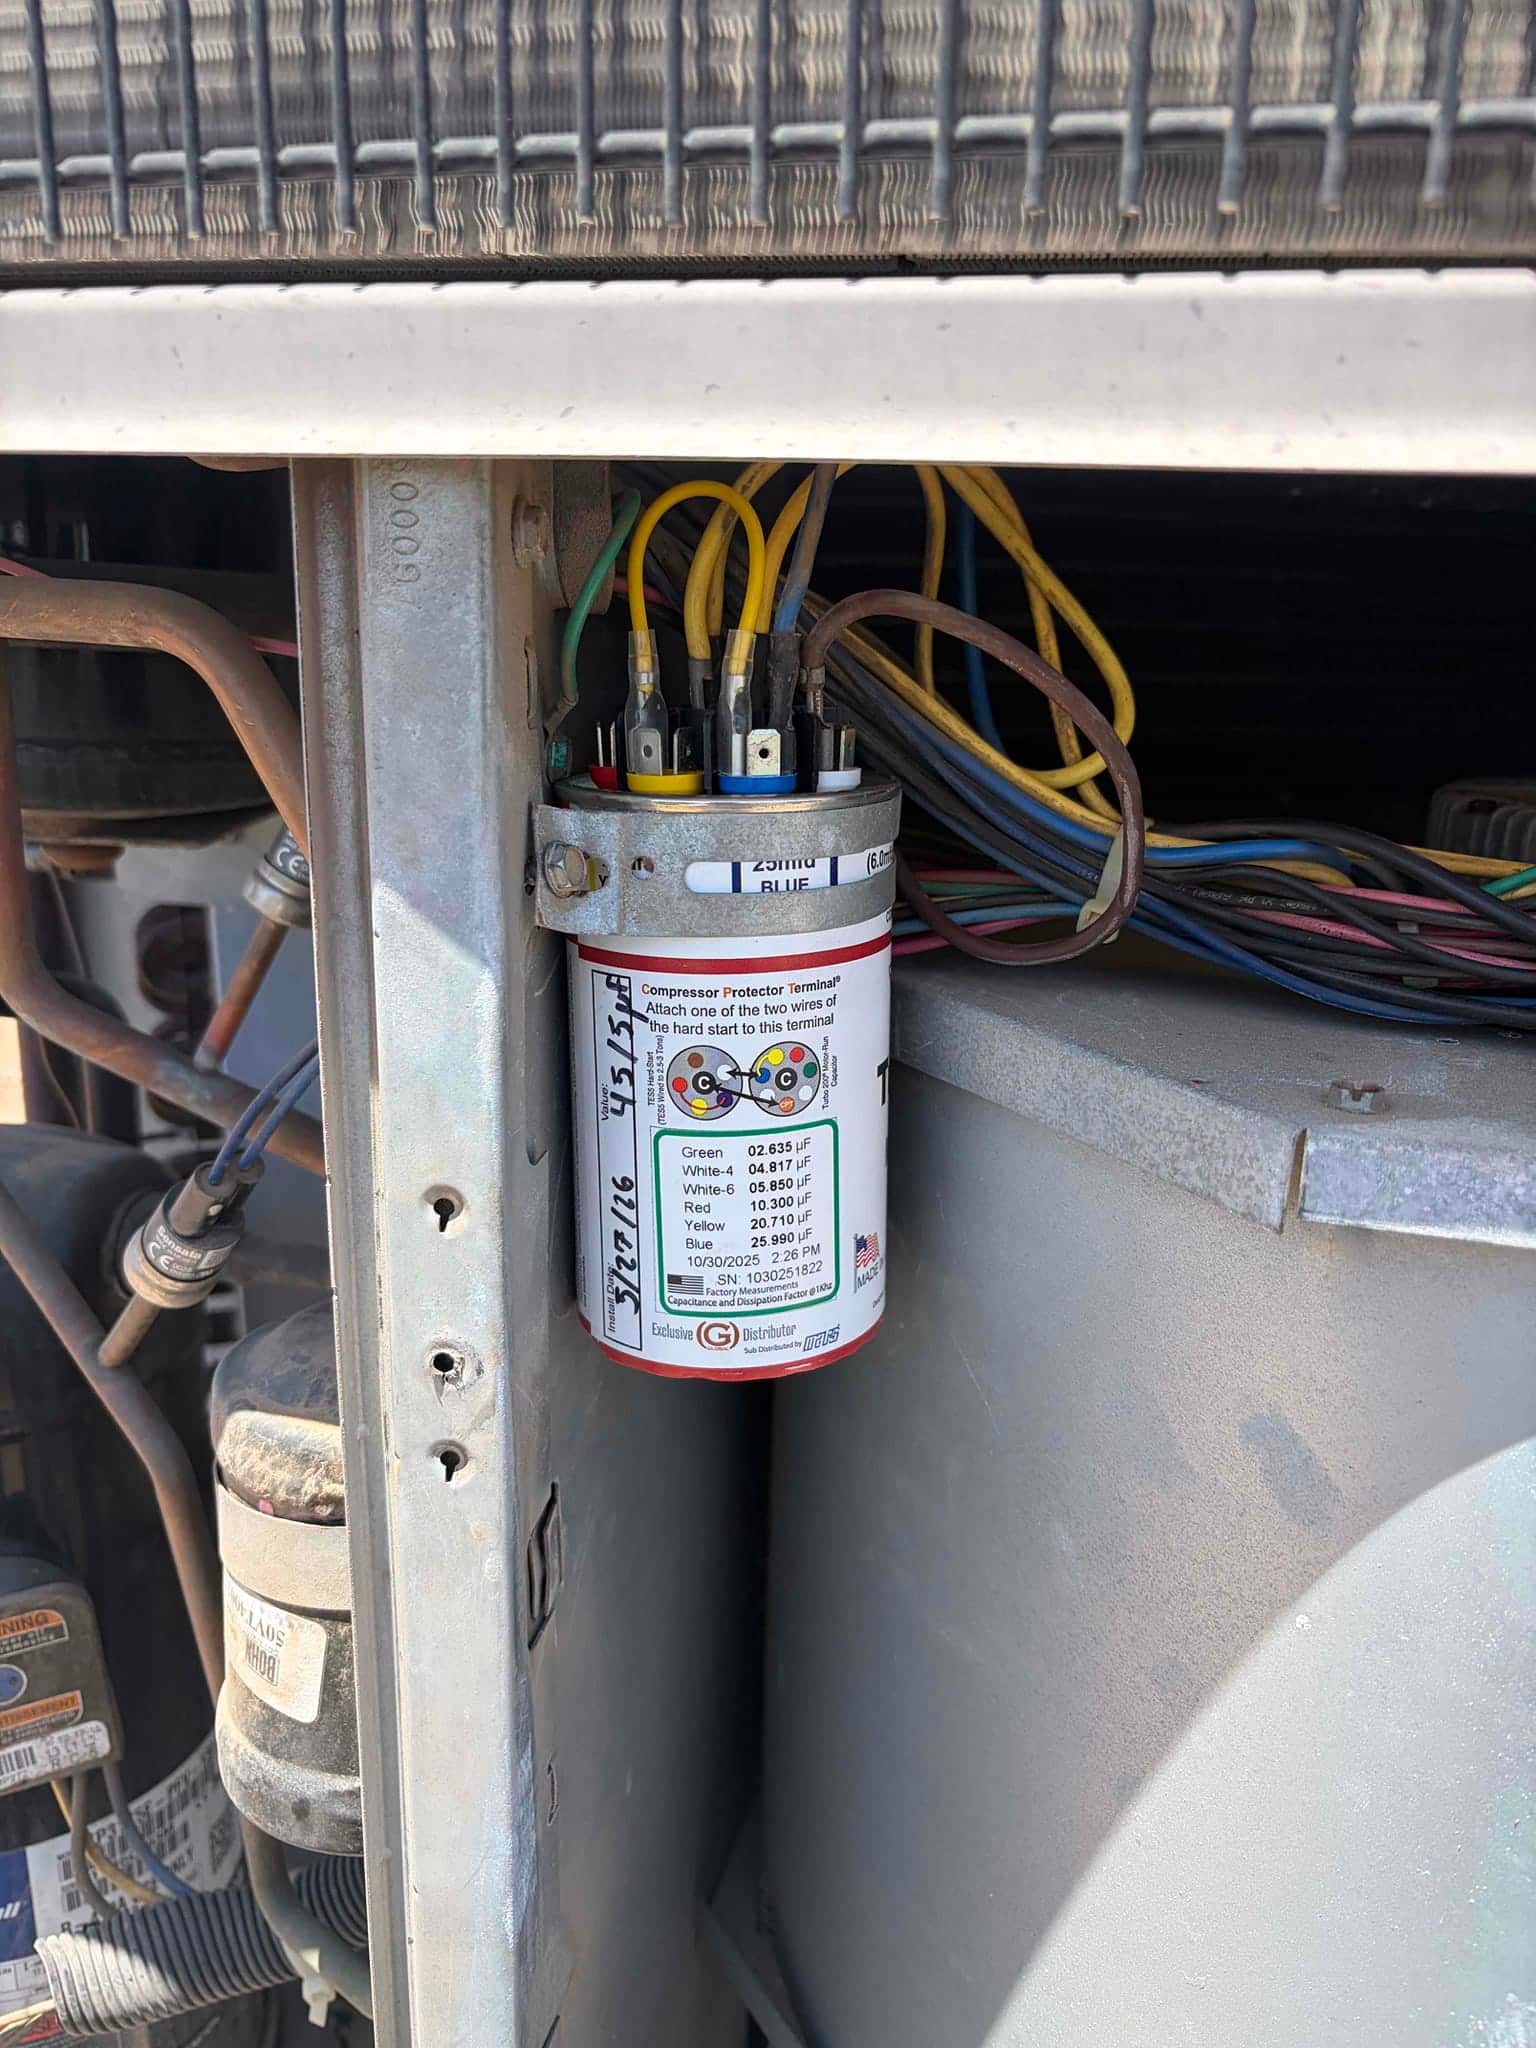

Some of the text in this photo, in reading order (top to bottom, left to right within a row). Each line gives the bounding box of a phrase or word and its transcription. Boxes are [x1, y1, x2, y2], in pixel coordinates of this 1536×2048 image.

[641, 984, 719, 1000] Compressor
[723, 984, 784, 998] Protector
[645, 994, 838, 1017] Attach one of the two wires of
[649, 1013, 834, 1035] the hard start to this terminal
[646, 1051, 654, 1086] Hard-Start
[656, 1074, 665, 1082] to
[698, 1077, 711, 1090] C
[781, 1071, 792, 1086] C
[601, 1083, 609, 1121] Value:
[681, 1146, 723, 1159] Green
[748, 1140, 793, 1157] 02.635
[682, 1165, 734, 1177] White-4
[748, 1159, 793, 1175] 04.817
[683, 1183, 735, 1195] White-6
[749, 1177, 794, 1193] 05.850
[684, 1201, 711, 1213] Red
[750, 1196, 794, 1211] 10.300
[684, 1219, 725, 1232] Yellow
[750, 1213, 794, 1230] 20.710
[685, 1238, 713, 1249] Blue
[751, 1232, 795, 1248] 25.990
[687, 1244, 821, 1268] 10/30/2025 2:26 PM
[717, 1261, 823, 1286] SN: 1030251822
[857, 1262, 879, 1288] MADE
[667, 1295, 717, 1308] Capacitance
[719, 1295, 735, 1306] and
[737, 1294, 783, 1307] Dissipation
[784, 1289, 808, 1302] Factor
[706, 1281, 799, 1297] Factory Measurements
[607, 1298, 616, 1334] Install
[652, 1322, 693, 1341] Exclusive
[743, 1323, 797, 1341] Distributor
[744, 1347, 756, 1355] Sub
[757, 1341, 794, 1353] Distributed
[795, 1341, 802, 1350] by
[0, 1612, 49, 1637] NING
